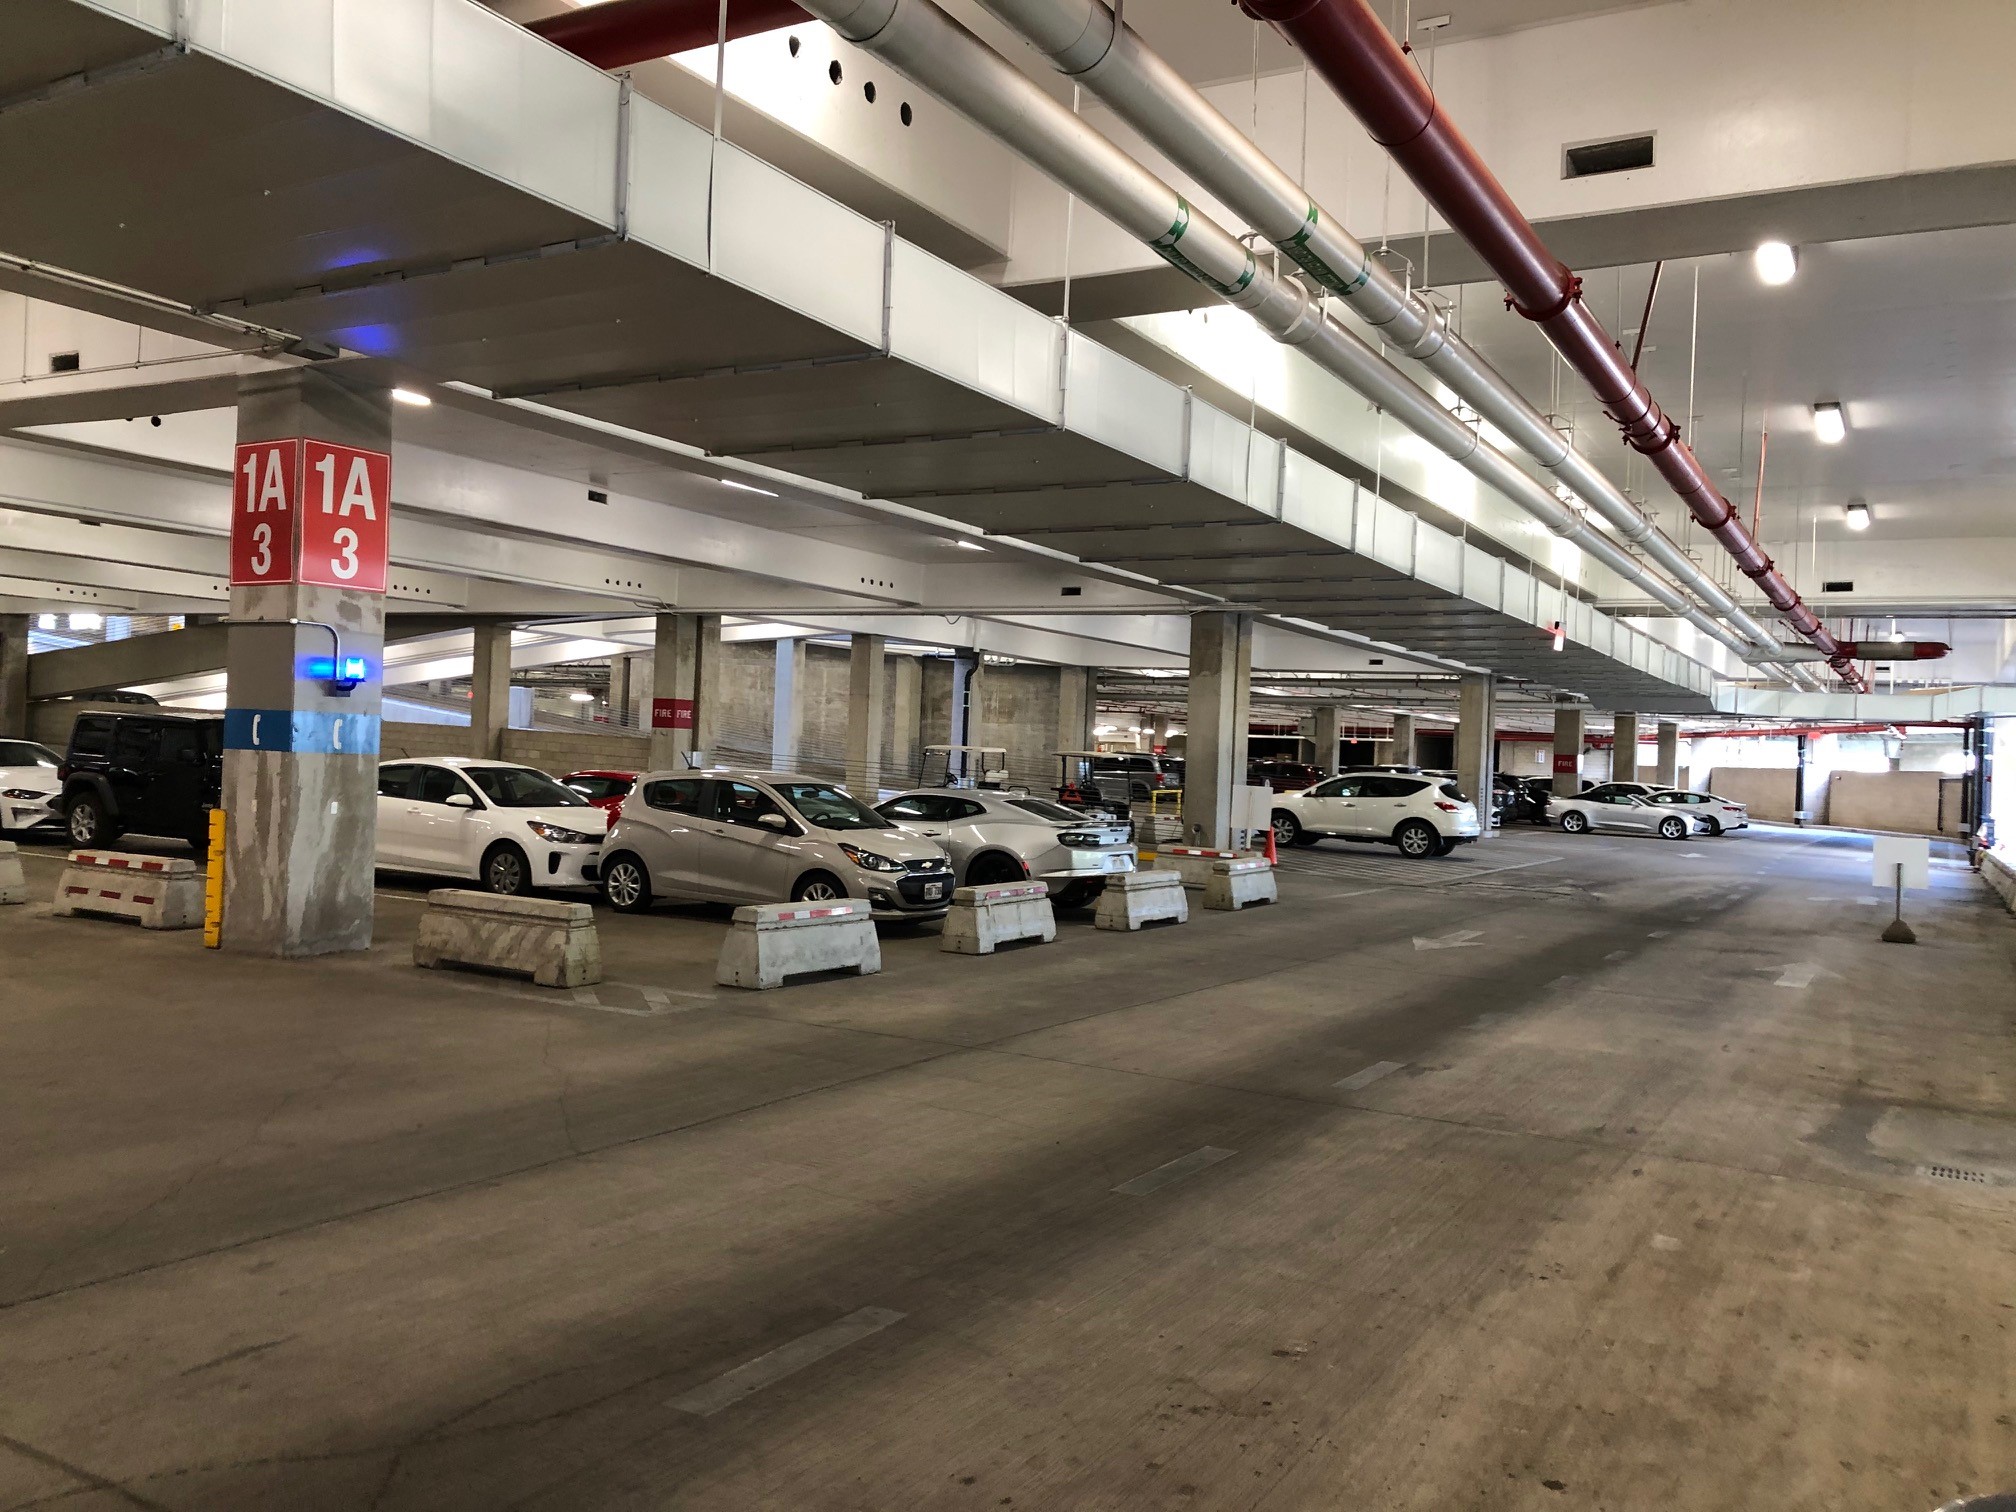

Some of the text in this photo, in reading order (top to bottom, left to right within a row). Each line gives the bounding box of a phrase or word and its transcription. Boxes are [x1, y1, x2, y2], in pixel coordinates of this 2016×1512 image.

[243, 448, 287, 513] 1A
[315, 453, 377, 521] 1A
[251, 522, 272, 576] 3
[330, 527, 359, 580] 3
[654, 708, 672, 718] FIRE
[676, 709, 692, 719] FIRE
